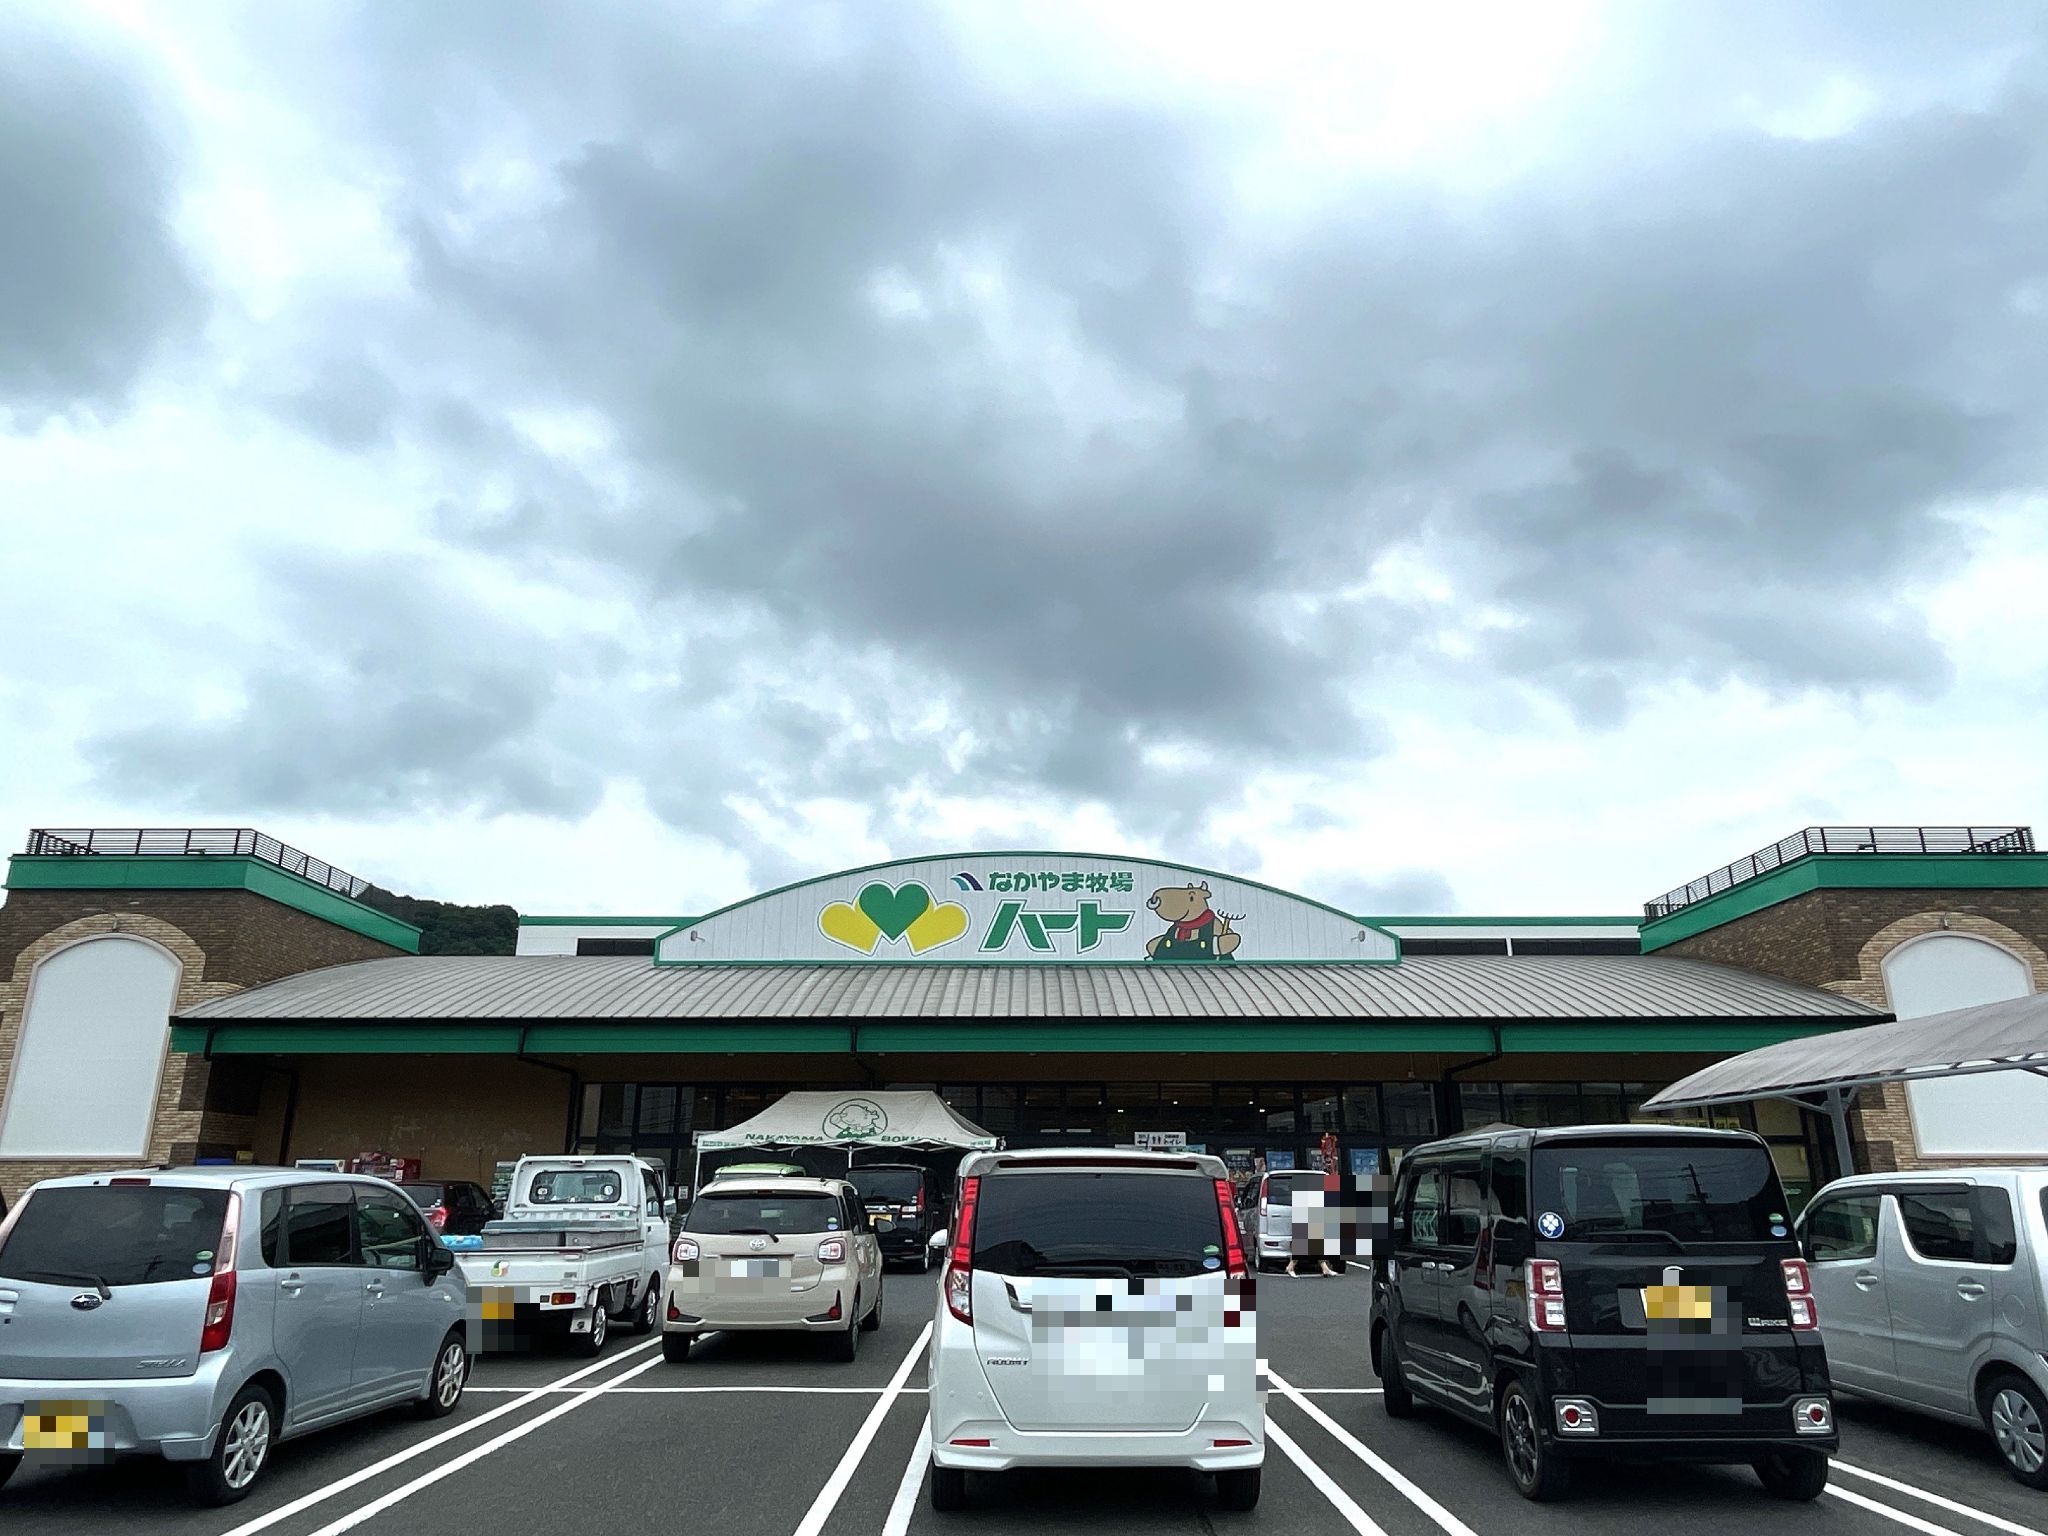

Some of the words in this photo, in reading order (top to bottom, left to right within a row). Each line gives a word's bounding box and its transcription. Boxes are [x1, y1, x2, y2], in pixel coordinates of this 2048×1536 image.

[988, 871, 1135, 893] なかやま牧場
[980, 900, 1135, 953] ハート
[745, 1133, 824, 1142] NAKAYAMA
